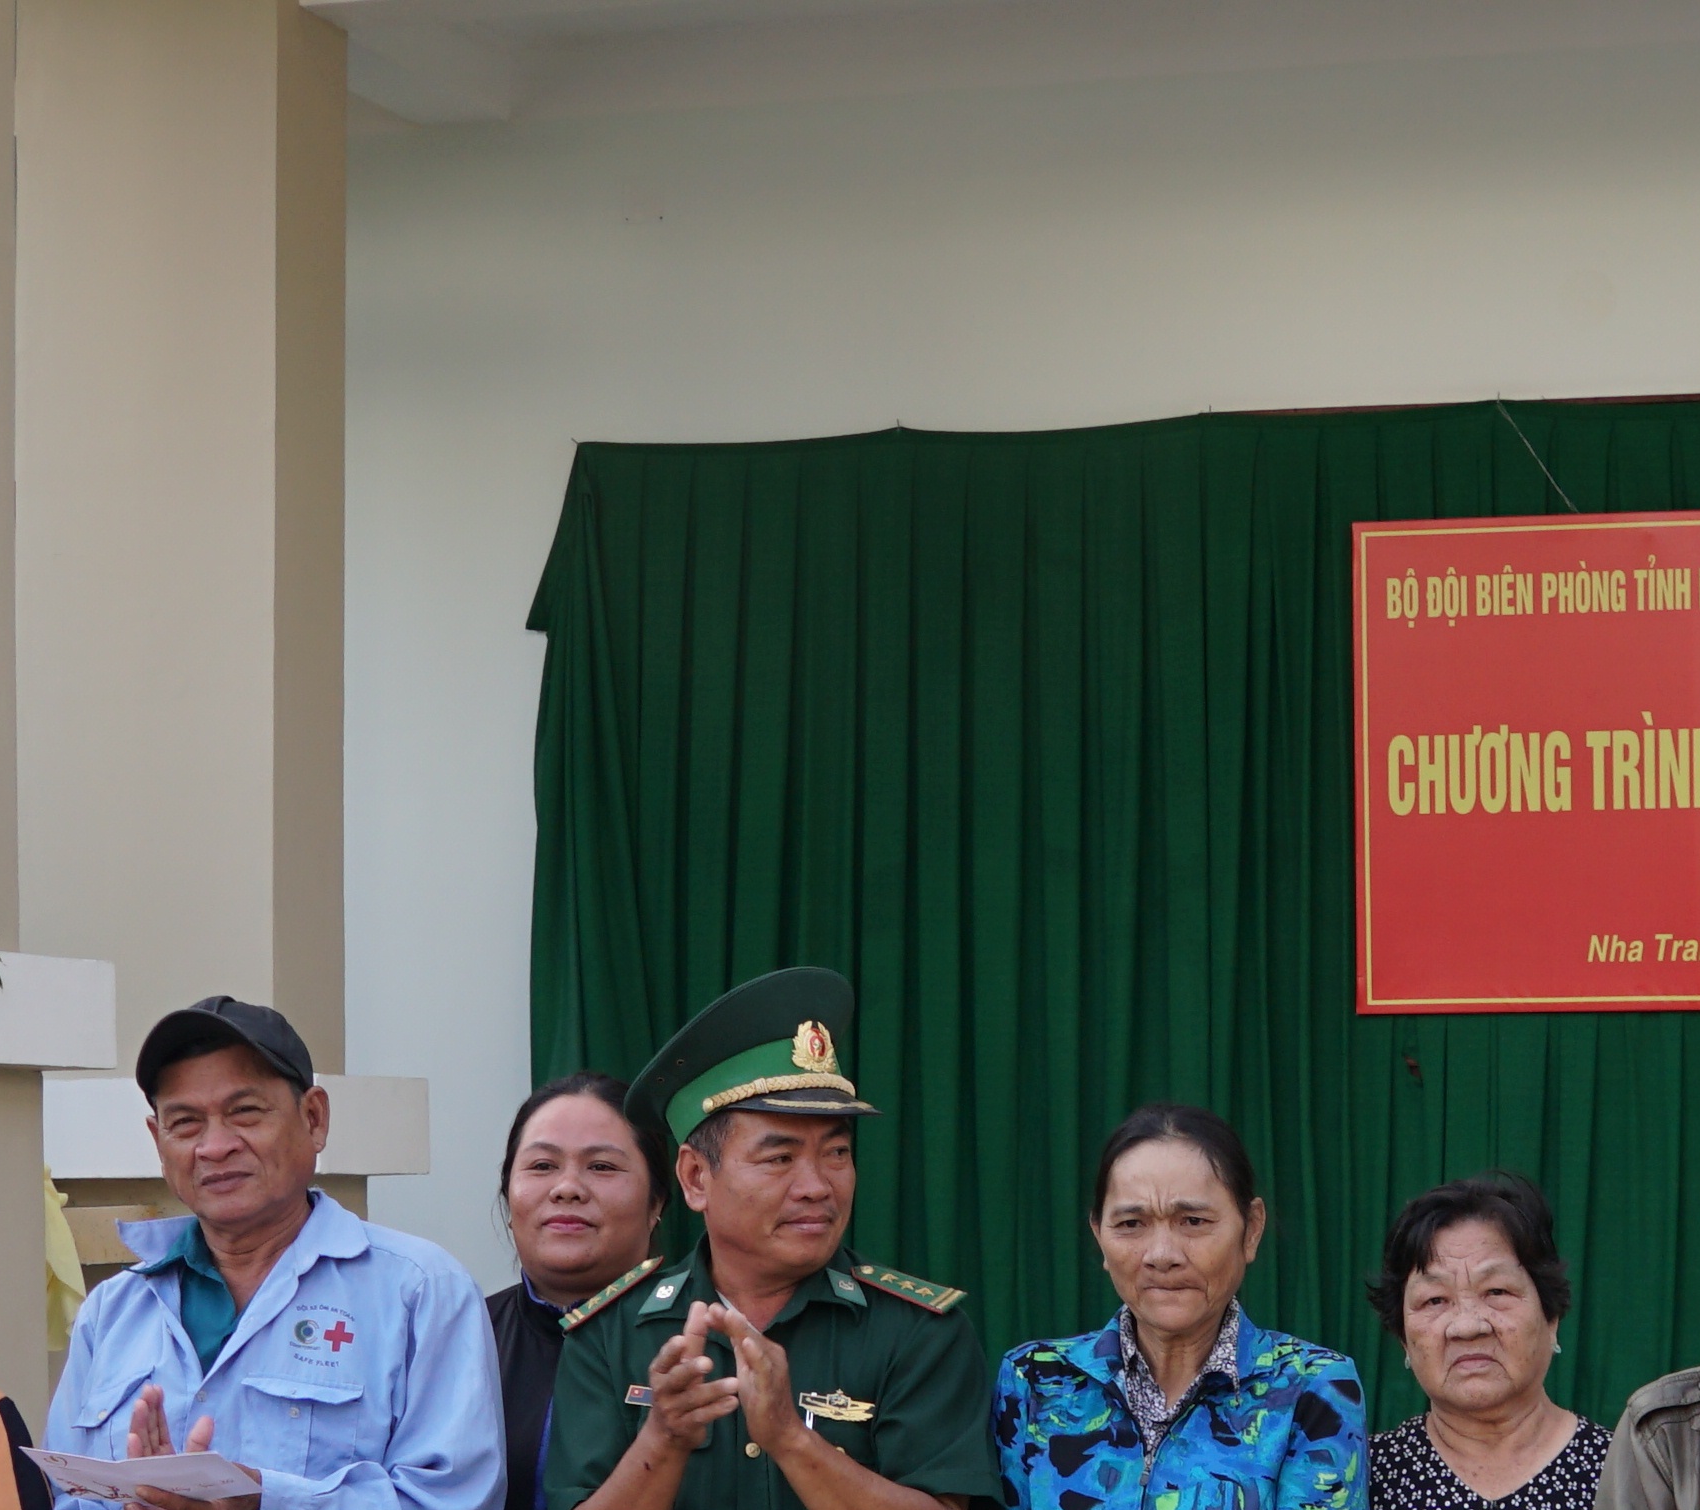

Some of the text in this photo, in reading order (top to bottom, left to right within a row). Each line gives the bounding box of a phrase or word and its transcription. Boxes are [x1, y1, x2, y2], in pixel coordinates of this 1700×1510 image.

[1386, 568, 1418, 627] BỘ
[1426, 567, 1467, 626] ĐỘI
[1476, 565, 1533, 615] BIÊN
[1541, 561, 1625, 613] PHÒNG
[1633, 554, 1690, 610] TỈNH
[1388, 724, 1571, 815] CHƯƠNG
[1587, 934, 1643, 962] Nha
[294, 1353, 314, 1364] SAFE
